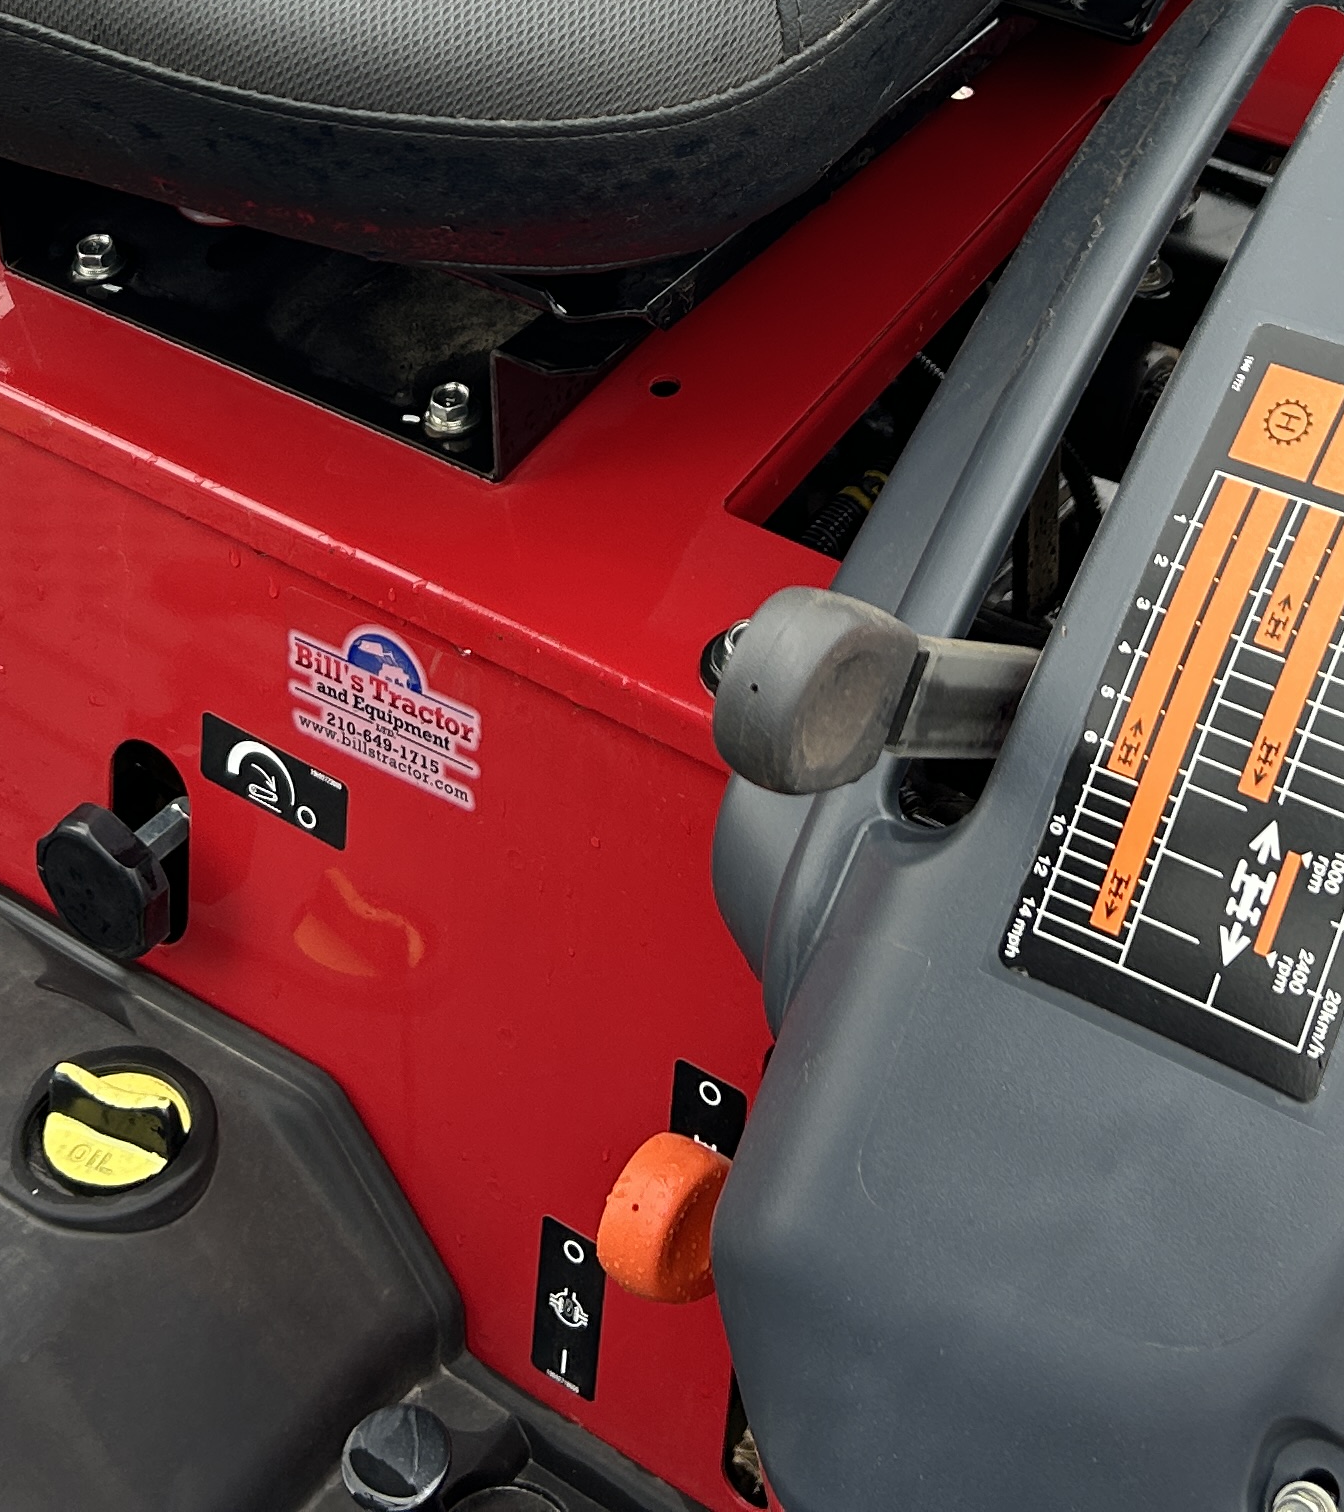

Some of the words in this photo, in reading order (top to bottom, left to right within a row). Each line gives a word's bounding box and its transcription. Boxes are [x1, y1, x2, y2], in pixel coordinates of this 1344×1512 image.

[1275, 411, 1302, 433] H
[1173, 513, 1188, 524] 1
[1153, 553, 1169, 568] 2
[1136, 596, 1151, 611] 3
[1117, 640, 1133, 655] 4
[295, 641, 364, 694] Bill's
[369, 674, 475, 744] Tractor
[1100, 684, 1116, 700] 5
[316, 680, 349, 705] and
[352, 694, 451, 751] Equipment
[326, 711, 440, 775] 210-649-1715
[1083, 729, 1098, 745] 6
[298, 714, 469, 803] www.billstractor.com
[1049, 813, 1067, 837] 10
[1033, 854, 1051, 878] 12
[1307, 853, 1330, 895] rpm
[1017, 895, 1036, 920] 14
[1004, 917, 1027, 959] mph
[1272, 953, 1295, 995] rpm
[1288, 947, 1316, 997] 2400
[1306, 987, 1342, 1061] 20km/h
[67, 1143, 114, 1176] OIL
